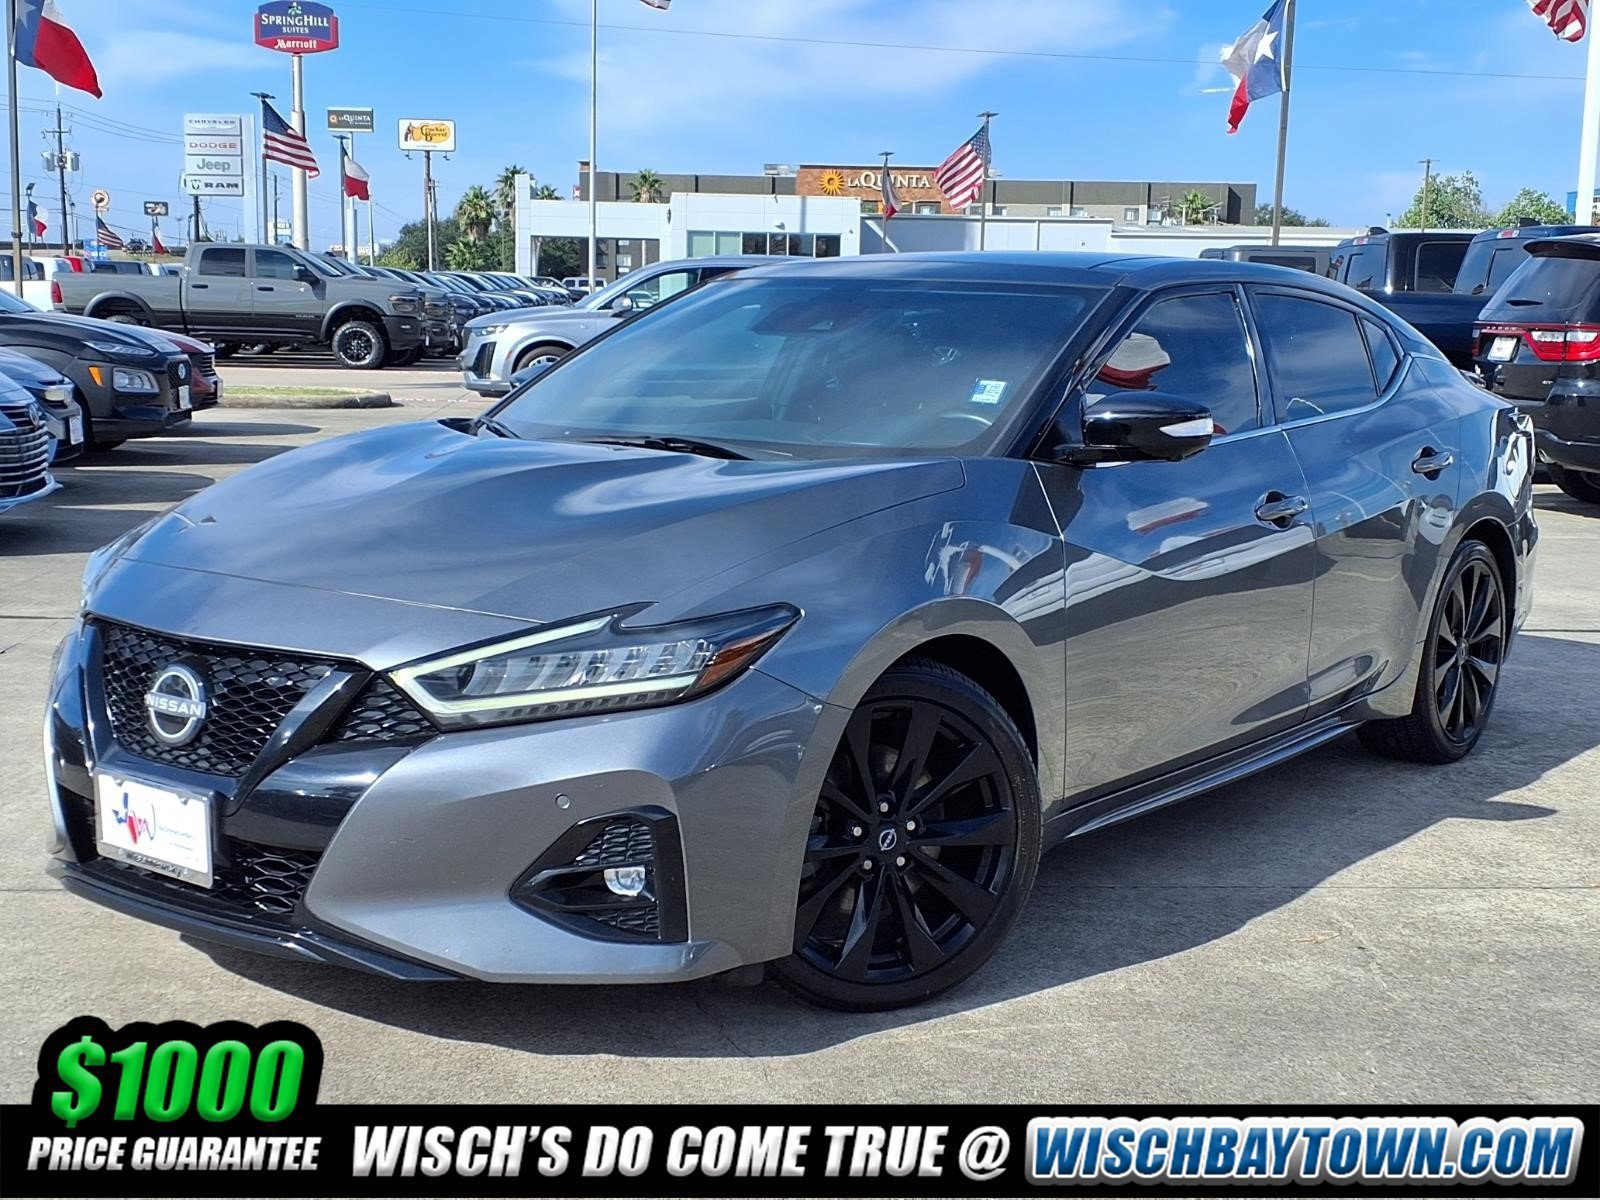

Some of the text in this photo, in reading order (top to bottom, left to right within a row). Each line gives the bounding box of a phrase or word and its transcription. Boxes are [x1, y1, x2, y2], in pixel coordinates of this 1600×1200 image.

[261, 13, 329, 26] SPRINGHILL
[274, 39, 317, 48] Marriott
[196, 157, 231, 172] Jeep
[146, 693, 202, 716] NISSAN
